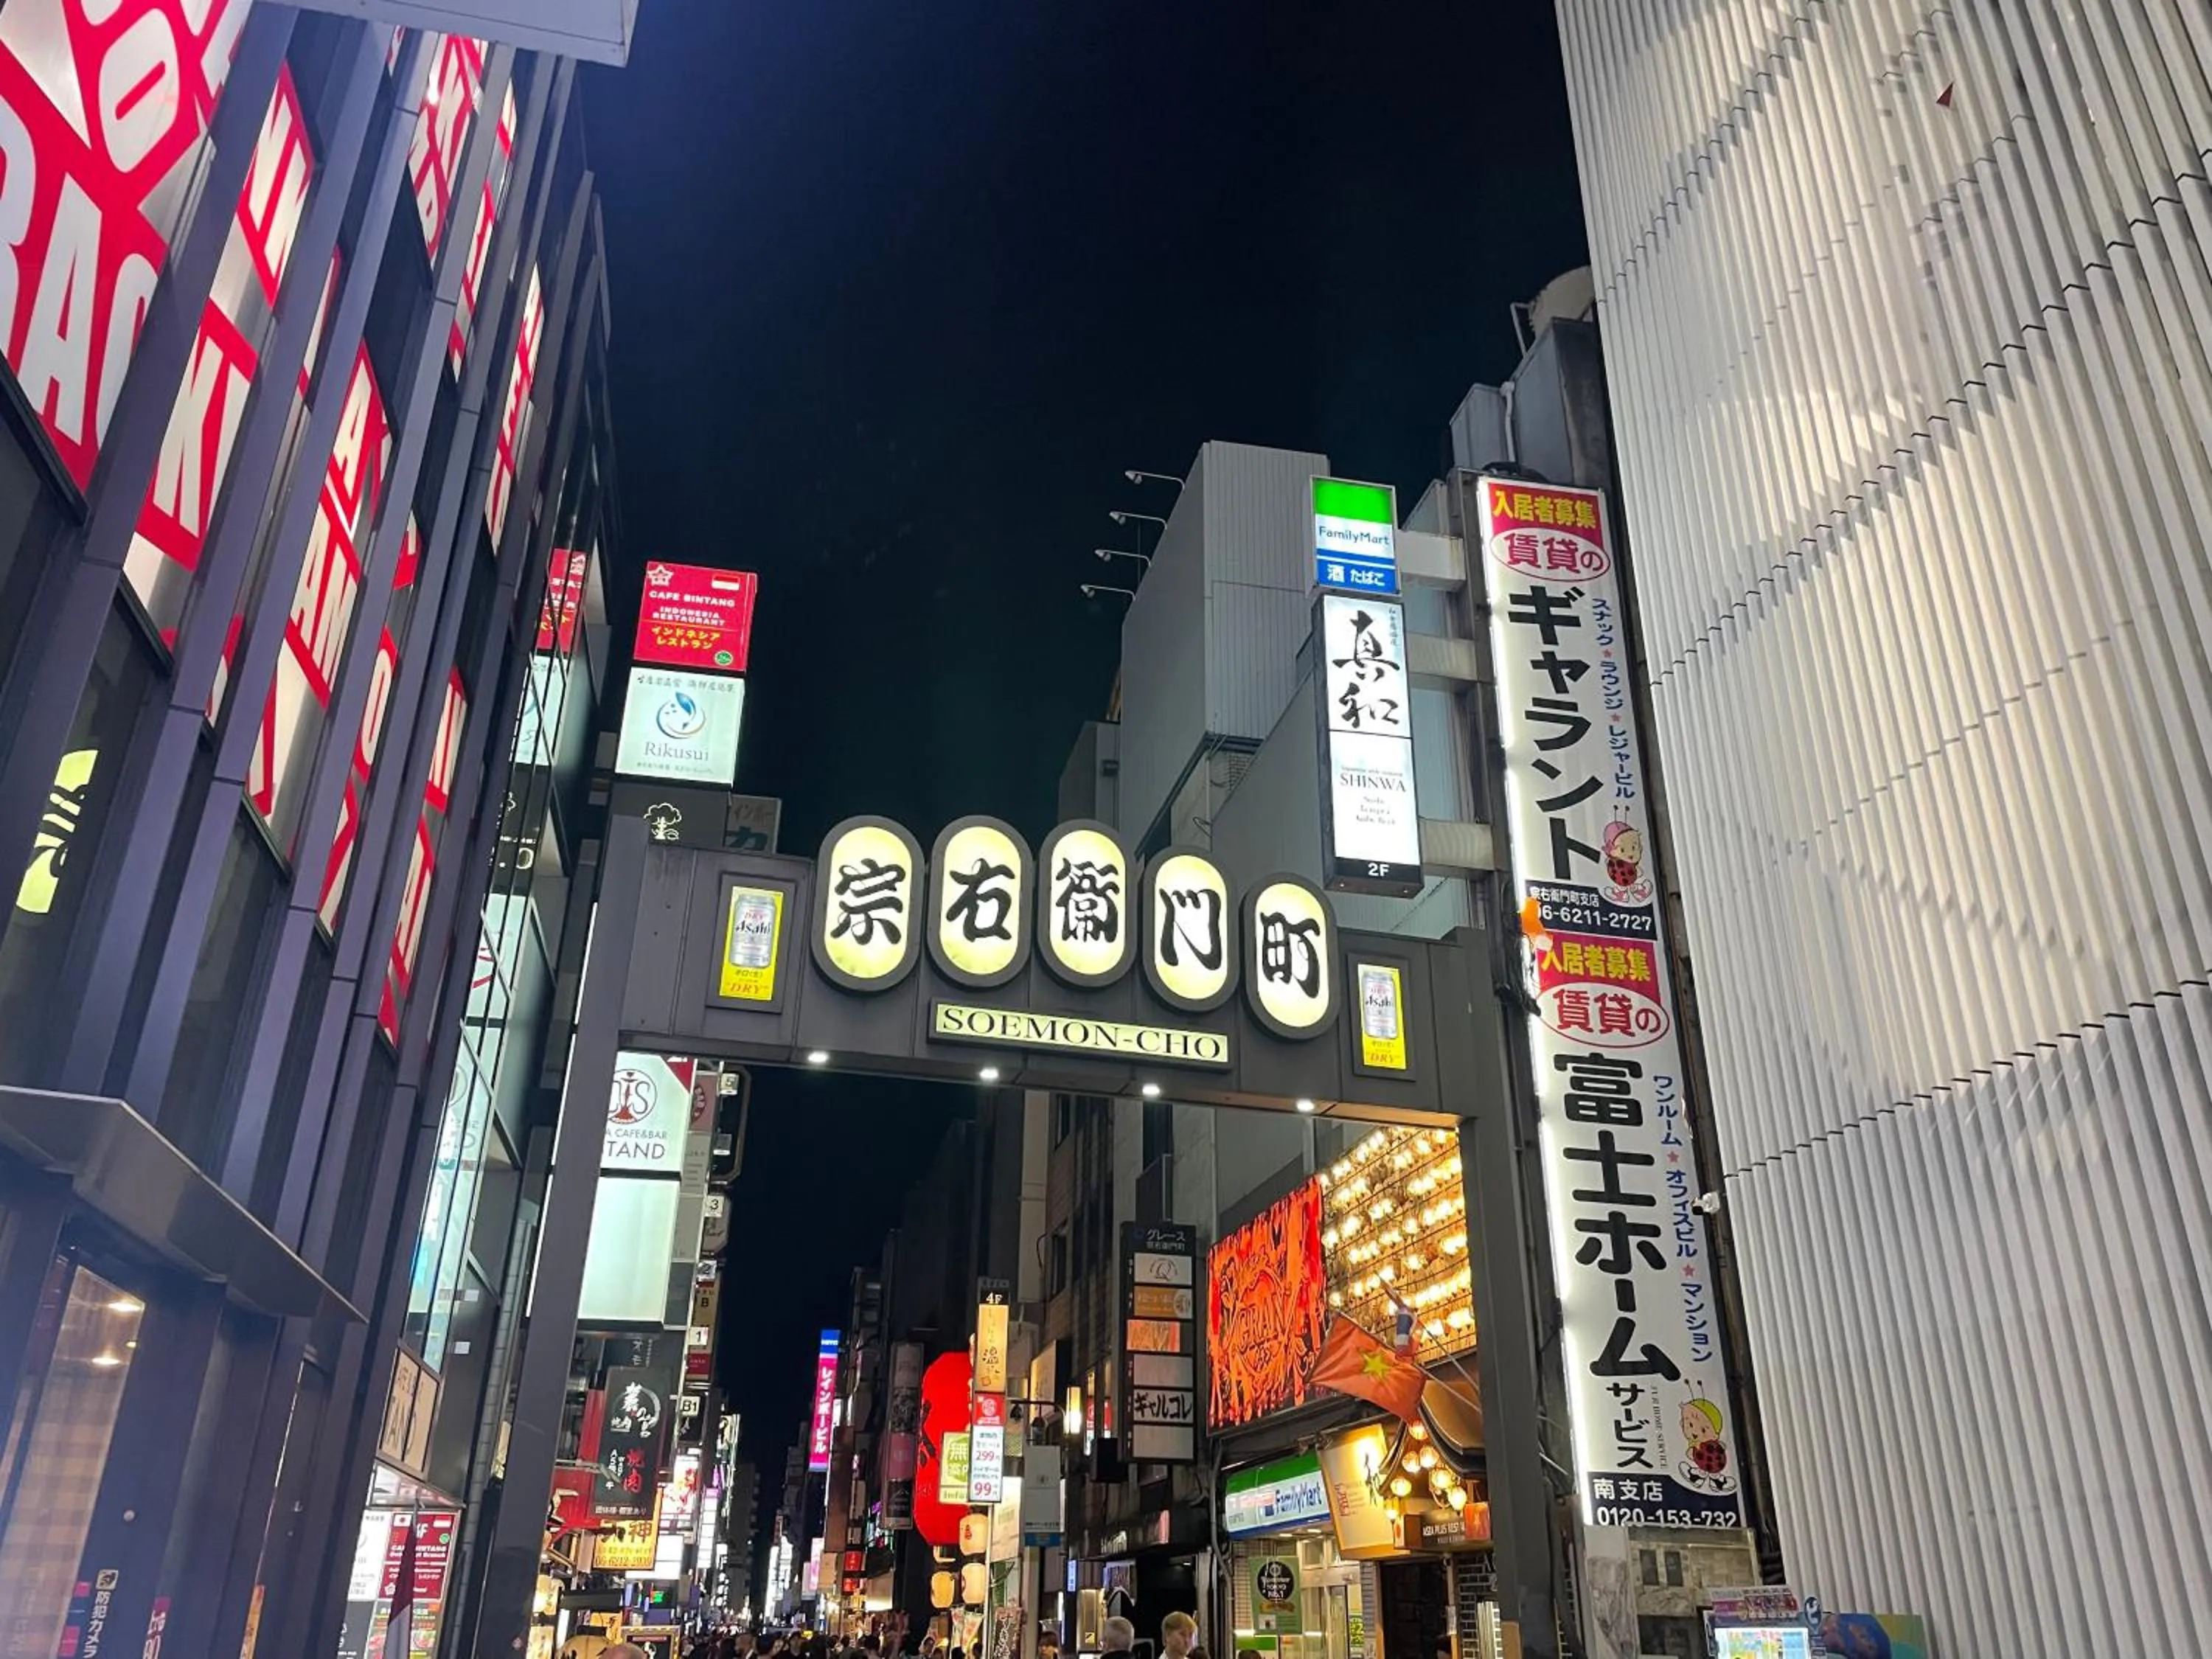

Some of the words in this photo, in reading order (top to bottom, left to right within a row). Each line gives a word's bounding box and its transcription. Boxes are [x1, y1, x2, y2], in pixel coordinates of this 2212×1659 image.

[1493, 490, 1596, 529] 入居者募集
[1318, 526, 1391, 545] FamilyMart
[1503, 532, 1604, 574] 賃貸の
[1327, 564, 1345, 582] 酒
[1350, 568, 1385, 586] たばこ
[649, 591, 680, 601] CAFE
[684, 594, 735, 608] BINTANG
[653, 612, 726, 626] RESTAURANT
[660, 606, 720, 619] INDONESIA
[1593, 598, 1613, 646] スナック
[652, 626, 720, 640] インドネシア
[657, 636, 712, 649] レストラン
[1601, 661, 1623, 709] ラウンジ
[1508, 585, 1604, 880] ギャラント
[644, 741, 709, 762] Rikusui
[1609, 725, 1635, 799] レジャービル
[1340, 772, 1406, 793] SHINWA
[1368, 862, 1390, 877] 2F
[736, 919, 771, 935] Asahi
[1541, 942, 1651, 981] 入居者募集
[1553, 989, 1660, 1037] 賃貸の
[942, 1007, 1221, 1060] SOEMON-CHO
[1653, 1076, 1683, 1146] ワンルーム
[614, 1128, 667, 1139] CAFE&BAR
[606, 1141, 666, 1160] TAND
[710, 1199, 719, 1210] 3
[1666, 1169, 1697, 1257] オフィスビル
[986, 1291, 1004, 1304] 4F
[1680, 1283, 1713, 1362] マンション
[681, 1401, 697, 1411] B1
[815, 1366, 833, 1453] レインボービル
[1134, 1391, 1192, 1420] ギャルコレ
[1606, 1382, 1654, 1469] サービス
[1275, 1482, 1322, 1516] FamilyMart
[1593, 1478, 1663, 1501] 南支店
[1596, 1506, 1736, 1528] 0120-153-732
